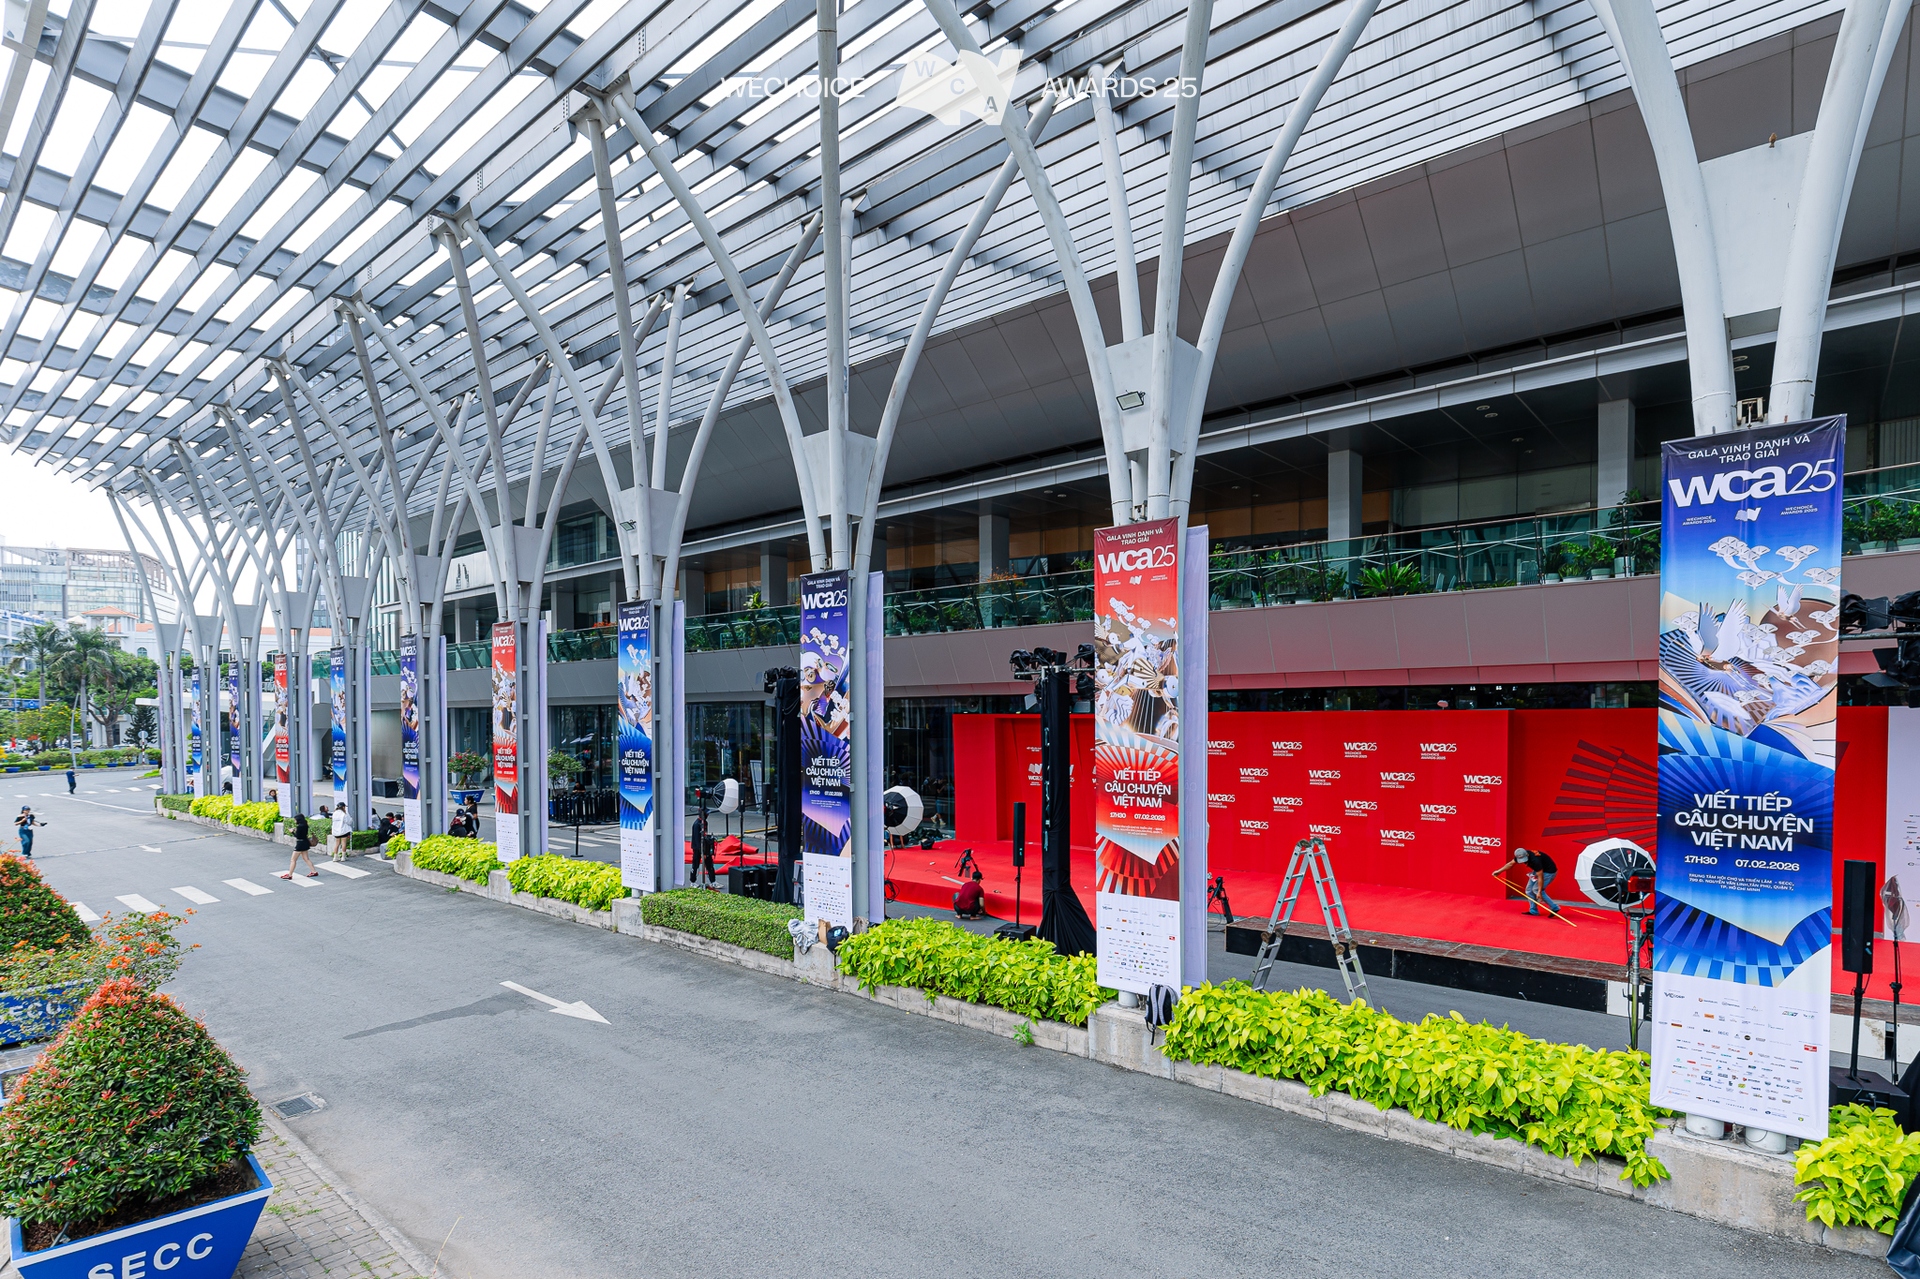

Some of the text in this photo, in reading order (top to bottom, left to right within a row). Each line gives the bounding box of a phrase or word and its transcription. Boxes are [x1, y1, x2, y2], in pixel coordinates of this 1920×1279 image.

[1688, 434, 1810, 459] GALA VINH DANH VÀ
[1719, 453, 1750, 464] TRAO
[1668, 458, 1836, 507] wca25
[1098, 544, 1175, 574] wca25
[802, 590, 848, 610] wca25
[1272, 742, 1302, 750] wca25
[1344, 742, 1377, 751] wca25
[1420, 743, 1457, 752] wca25
[1113, 766, 1161, 781] VIẾT TIẾP
[1240, 768, 1268, 776] wca25
[1309, 770, 1340, 779] wca25
[1380, 772, 1415, 781] wca25
[1464, 775, 1502, 785] wca25
[1105, 780, 1171, 797] CÂU CHUYỆN
[1113, 794, 1162, 808] VIỆT NAM
[1272, 797, 1302, 806] wca25
[1344, 800, 1377, 810] wca25
[1694, 789, 1792, 812] VIẾT TIẾP
[1420, 804, 1457, 814] wca25
[1240, 820, 1269, 829] wca25
[1675, 809, 1813, 836] CÂU CHUYỆN
[1309, 825, 1341, 834] wca25
[1380, 830, 1415, 840] wca25
[1691, 829, 1793, 851] VIỆT NAM
[1463, 836, 1501, 847] wca25
[1684, 855, 1718, 865] 17H30
[1735, 859, 1800, 871] 07.02.2026
